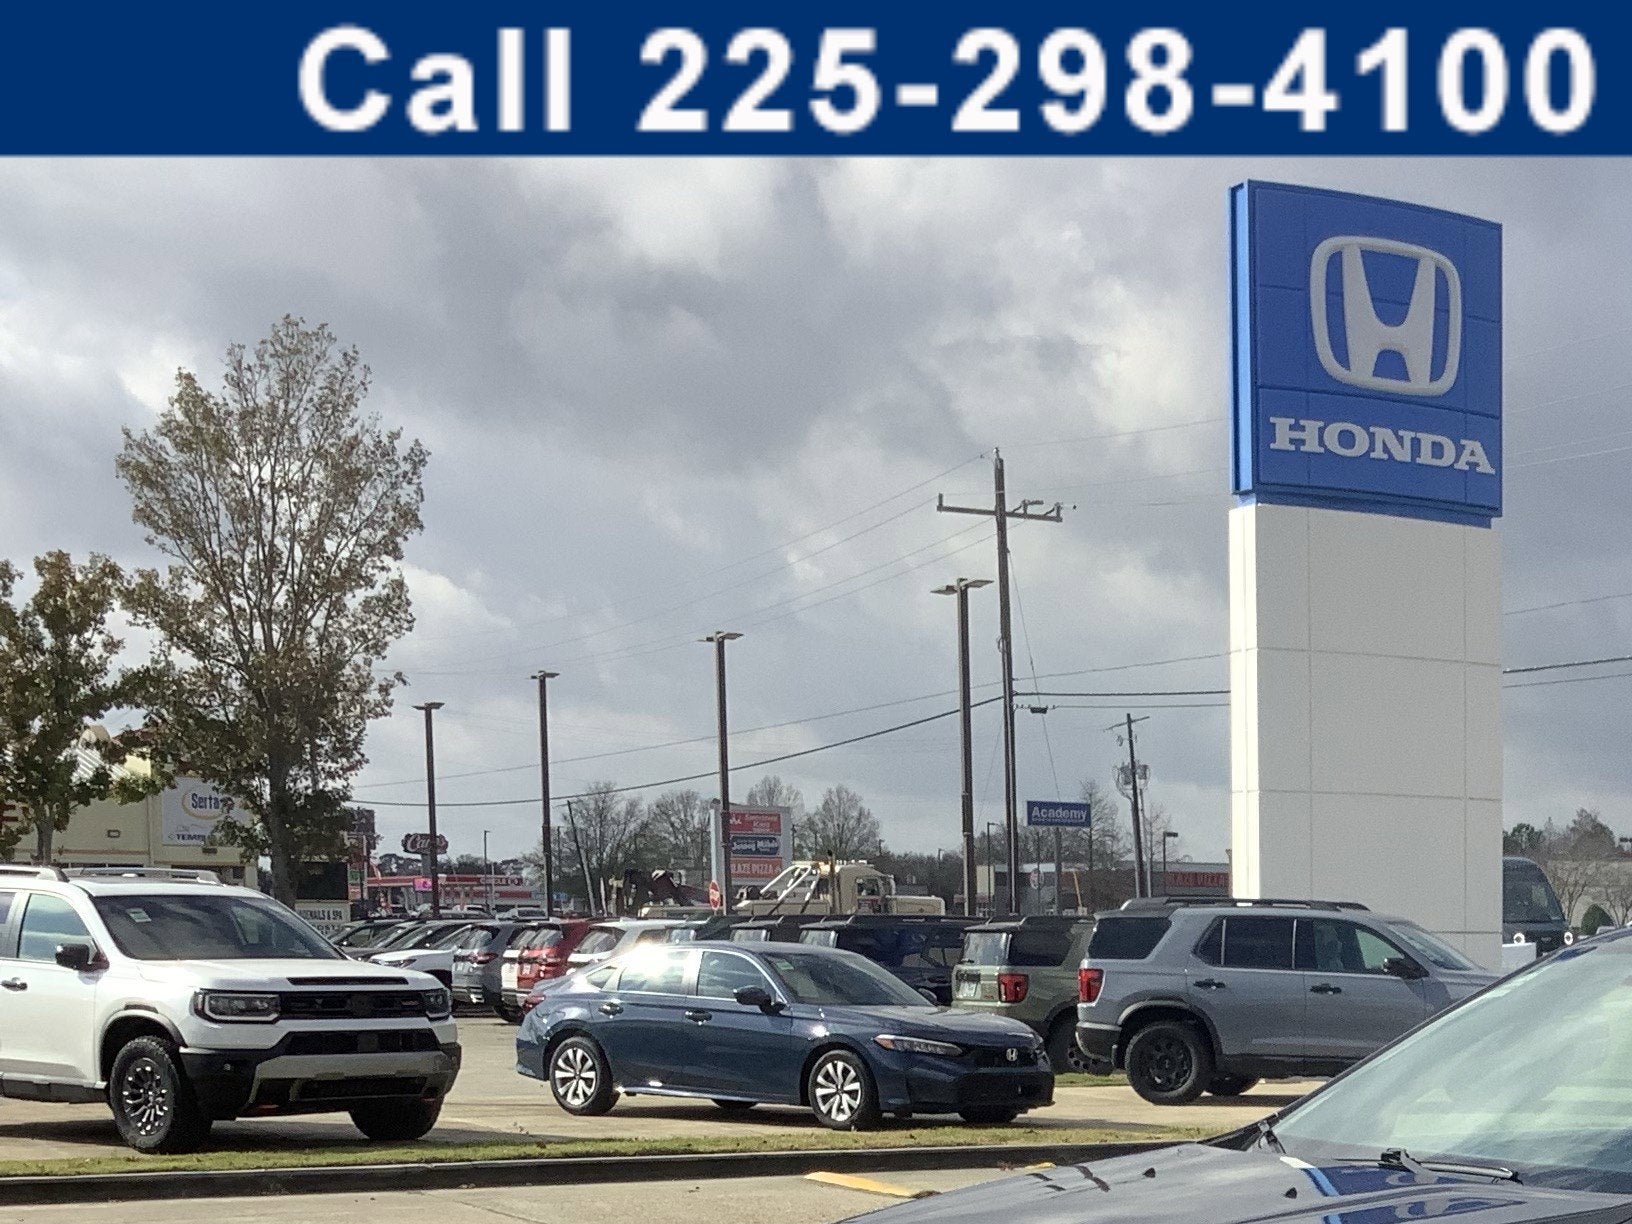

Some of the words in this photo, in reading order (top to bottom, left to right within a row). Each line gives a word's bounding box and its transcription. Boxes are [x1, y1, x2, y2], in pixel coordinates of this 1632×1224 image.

[1269, 416, 1496, 475] HONDA
[191, 792, 220, 810] Serta
[1031, 805, 1088, 822] Academy
